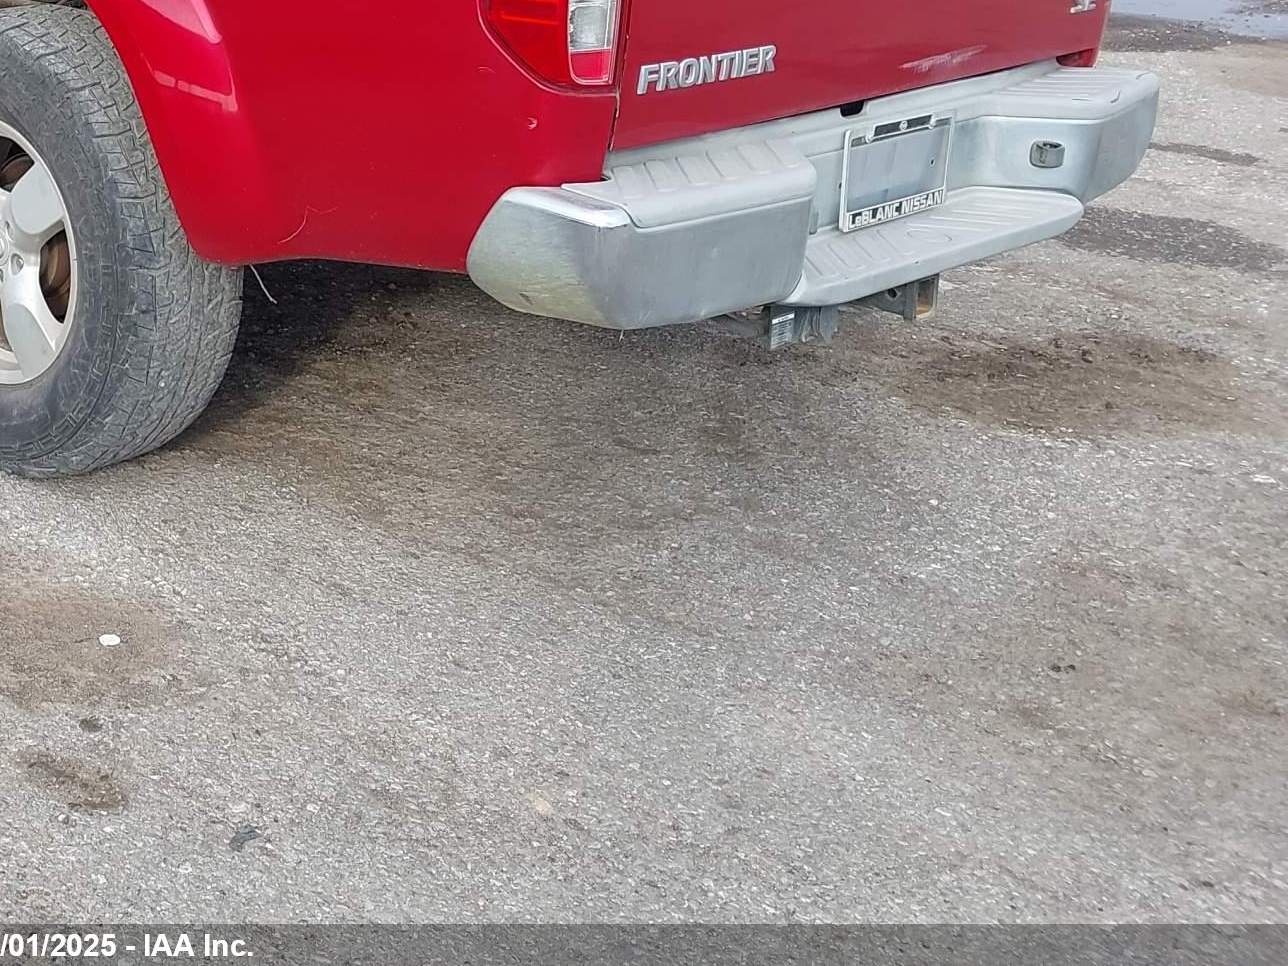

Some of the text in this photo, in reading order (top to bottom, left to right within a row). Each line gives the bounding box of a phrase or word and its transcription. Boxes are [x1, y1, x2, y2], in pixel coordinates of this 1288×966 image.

[636, 44, 777, 95] FRONTIER
[848, 190, 943, 229] LeBLANC NISSAN
